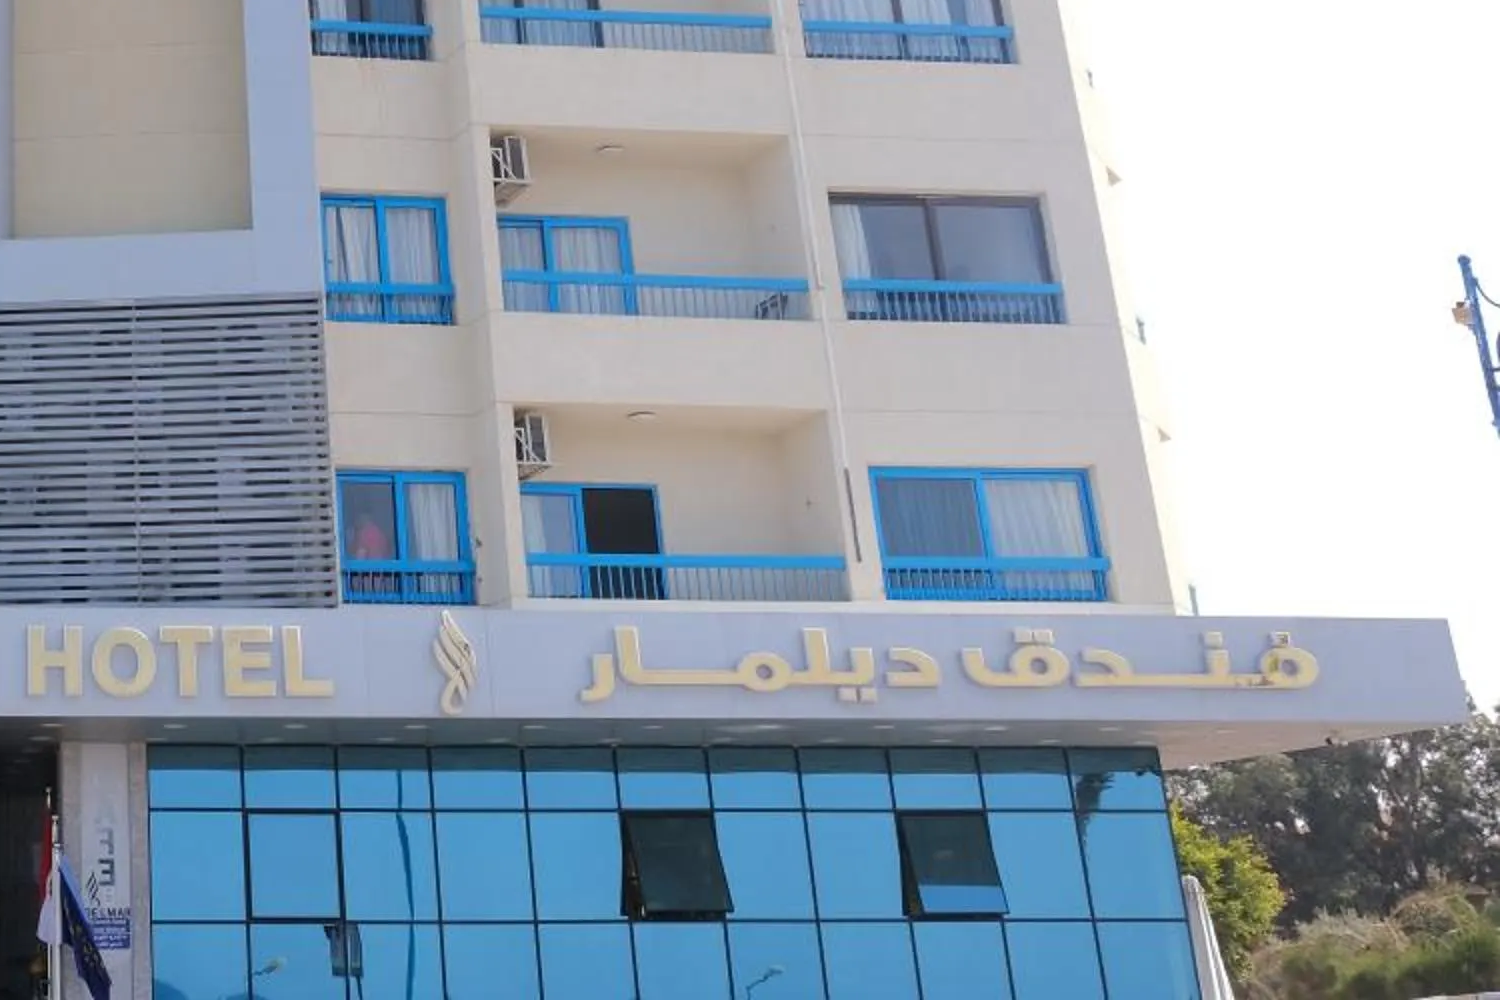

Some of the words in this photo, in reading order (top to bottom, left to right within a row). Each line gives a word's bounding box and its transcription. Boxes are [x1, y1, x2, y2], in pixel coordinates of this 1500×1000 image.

[26, 624, 335, 698] HOTEL
[579, 625, 941, 702] ديلمار
[961, 627, 1320, 689] فندق
